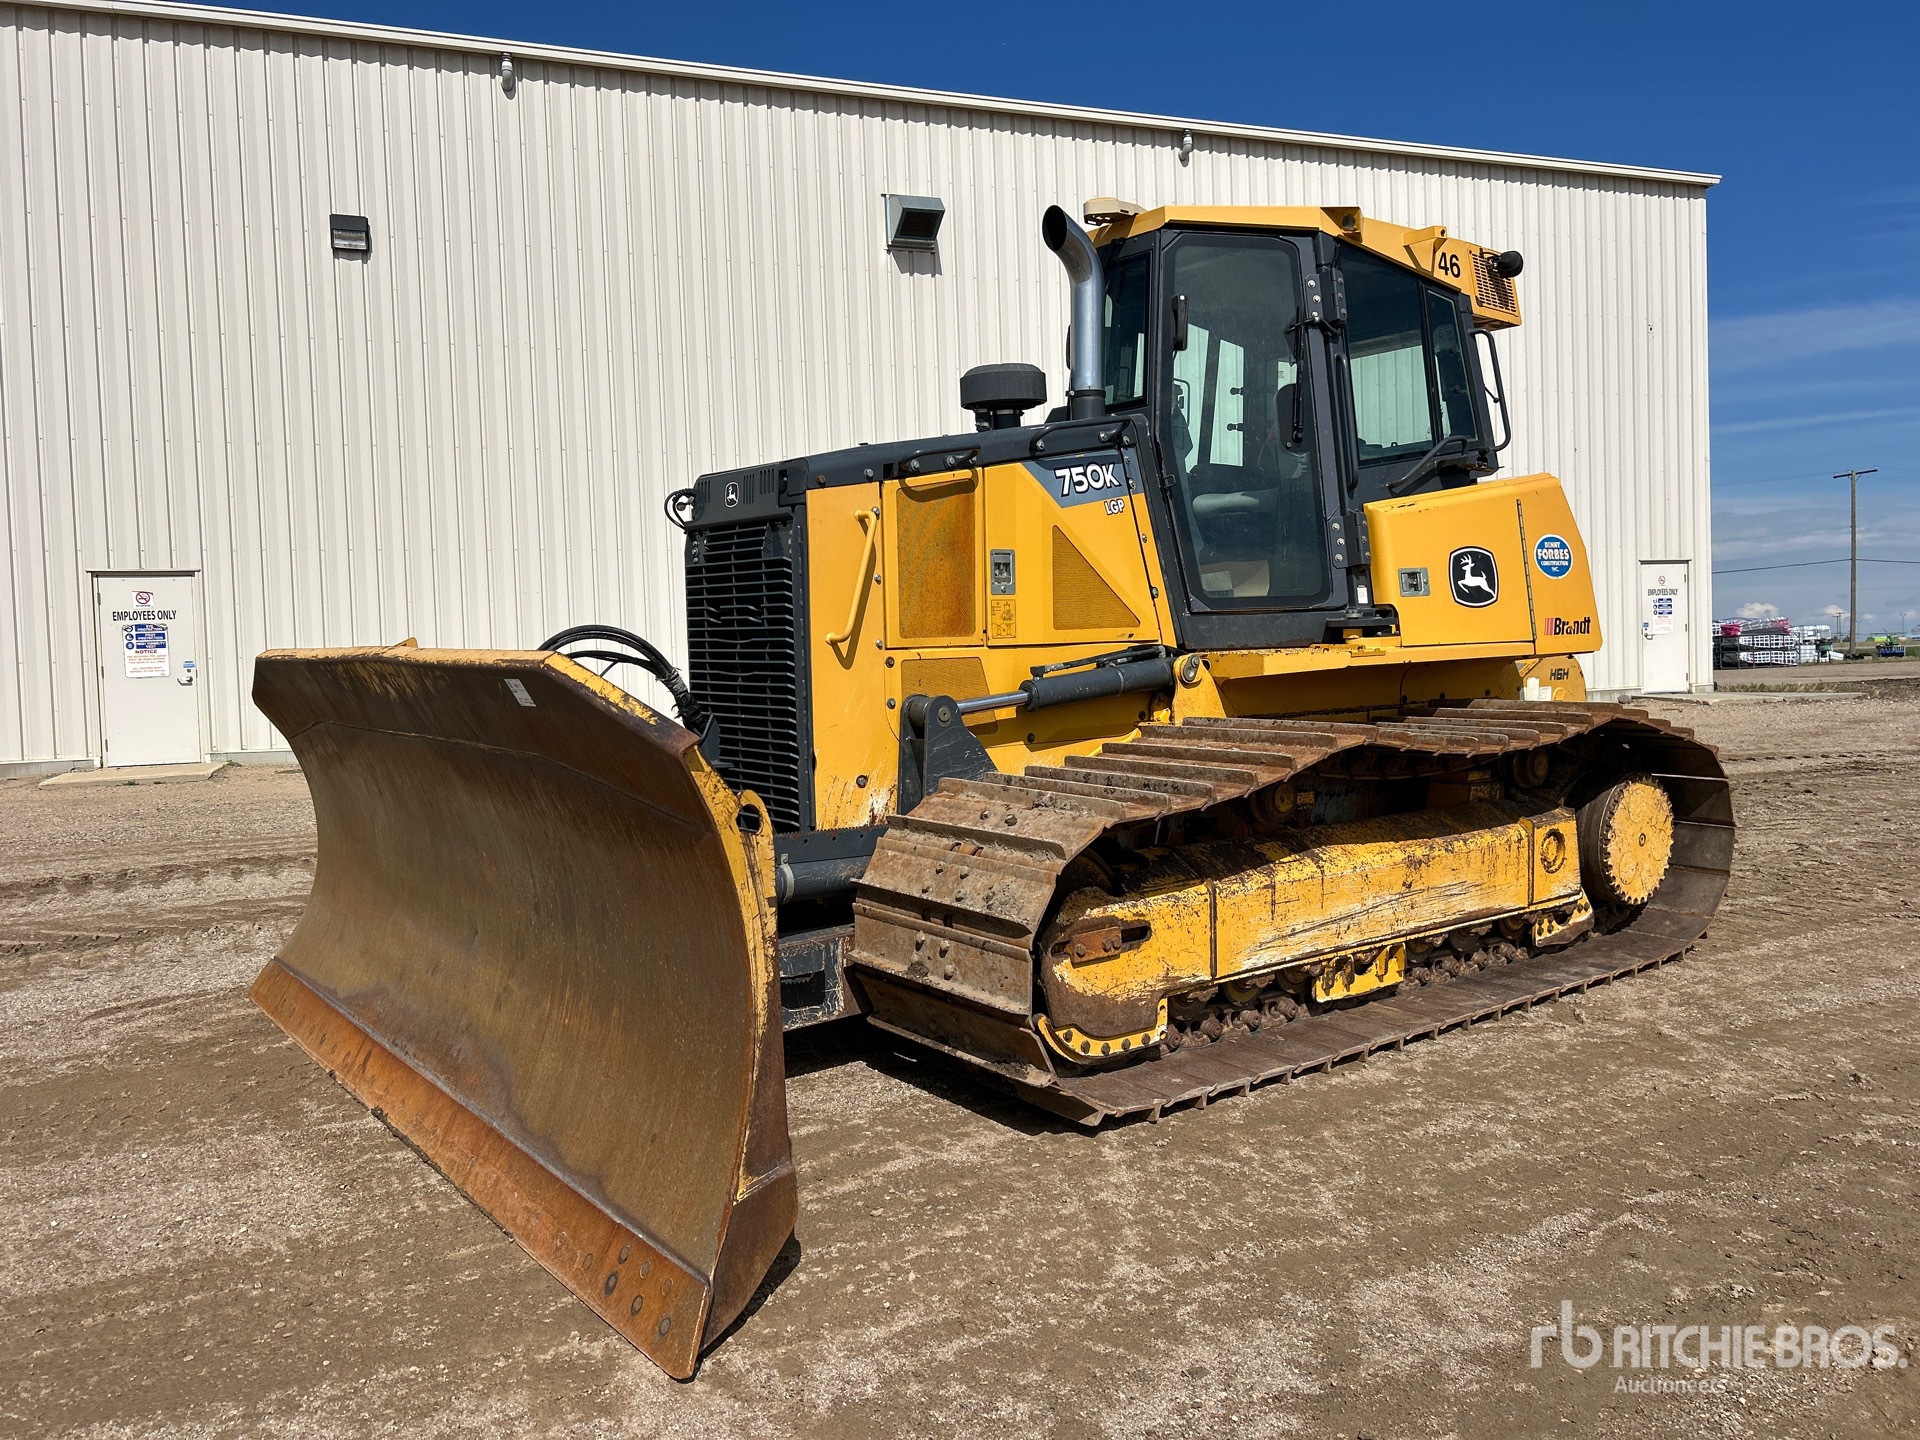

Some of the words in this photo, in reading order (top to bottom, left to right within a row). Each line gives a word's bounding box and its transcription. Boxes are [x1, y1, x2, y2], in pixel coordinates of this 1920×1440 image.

[1438, 252, 1461, 278] 46
[1054, 462, 1122, 497] 750K
[1104, 499, 1125, 515] LGP
[1537, 548, 1570, 560] FORBES
[112, 610, 156, 621] EMPLOYEES
[157, 609, 177, 620] ONLY
[1553, 616, 1592, 636] Brandt
